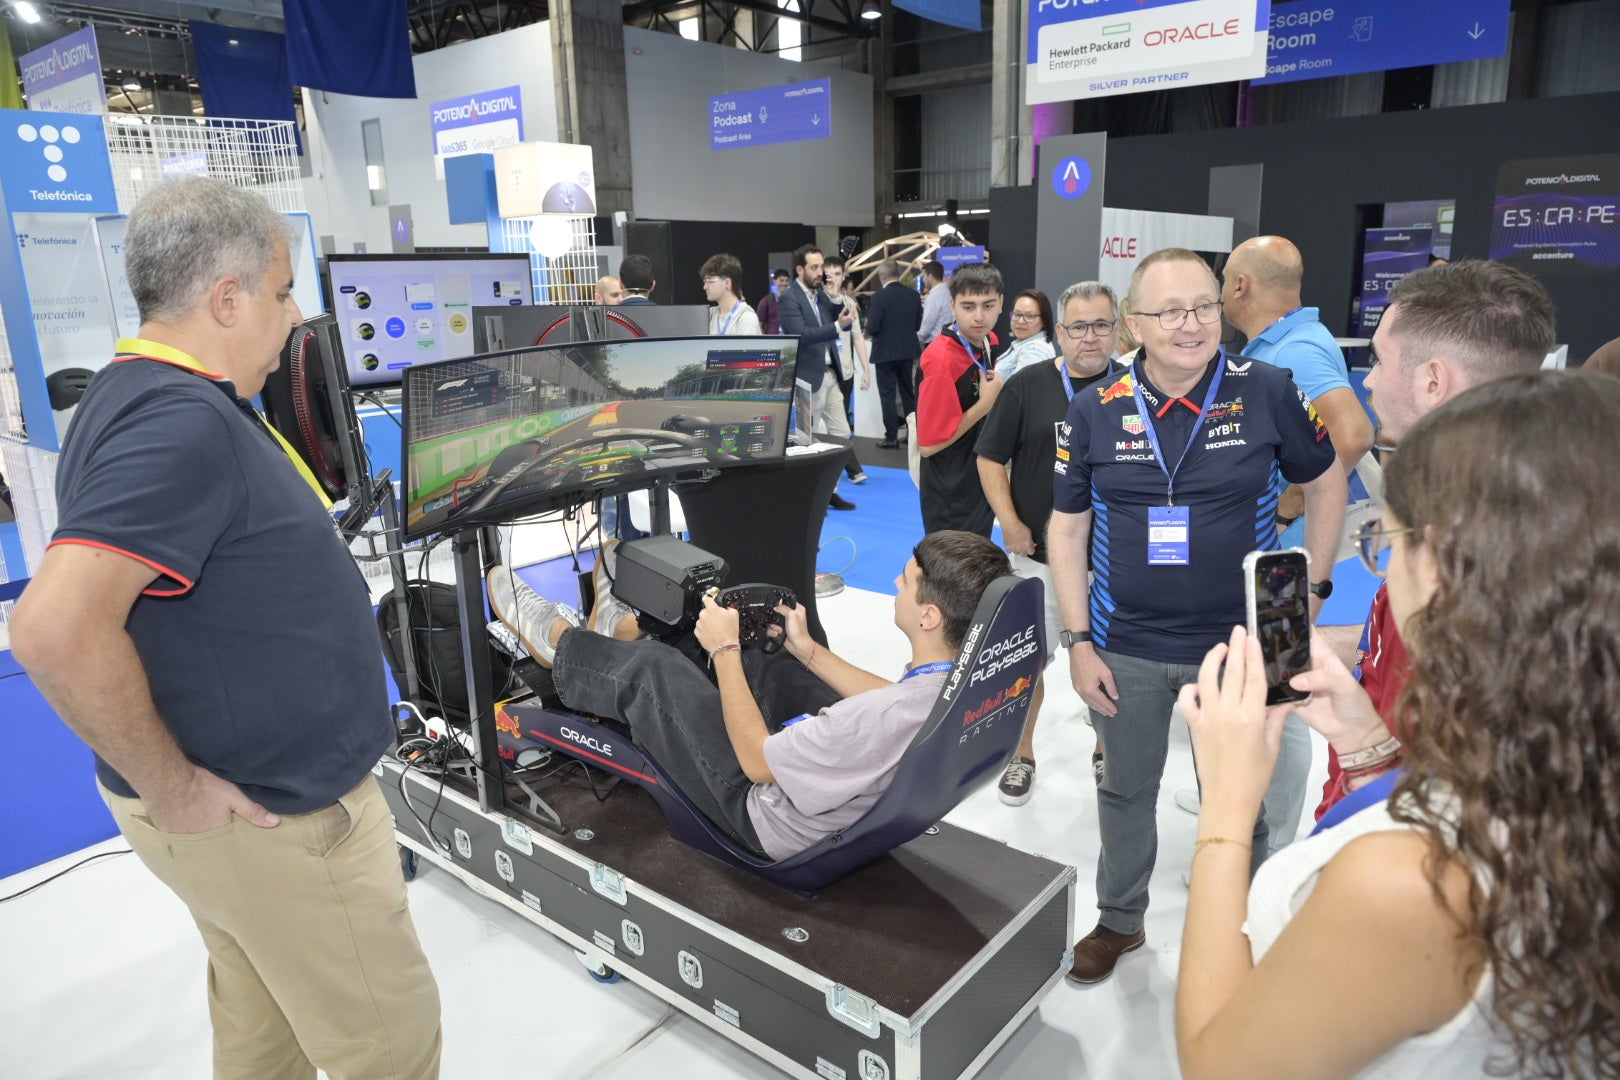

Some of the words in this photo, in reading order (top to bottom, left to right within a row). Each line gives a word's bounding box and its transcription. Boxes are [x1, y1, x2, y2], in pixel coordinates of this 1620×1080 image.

[1143, 19, 1239, 47] ORACLE
[1049, 46, 1088, 59] Hewlett
[1089, 38, 1131, 54] Packard
[1049, 56, 1098, 71] Enterprise
[1299, 58, 1333, 70] Room
[1089, 79, 1129, 91] SILVER
[1132, 72, 1189, 87] PARTNER
[713, 101, 737, 113] Zona
[713, 112, 752, 127] Podcast
[29, 190, 93, 202] Telefónica
[32, 237, 77, 246] Telefónica
[1101, 237, 1137, 258] ACLE
[1532, 252, 1575, 260] accenture
[1139, 382, 1159, 407] zoom
[1208, 421, 1241, 439] BYBIT
[1116, 440, 1144, 450] Mobil
[1205, 439, 1247, 450] HONDA
[978, 624, 1035, 665] ORACLE
[560, 726, 613, 757] ORACLE
